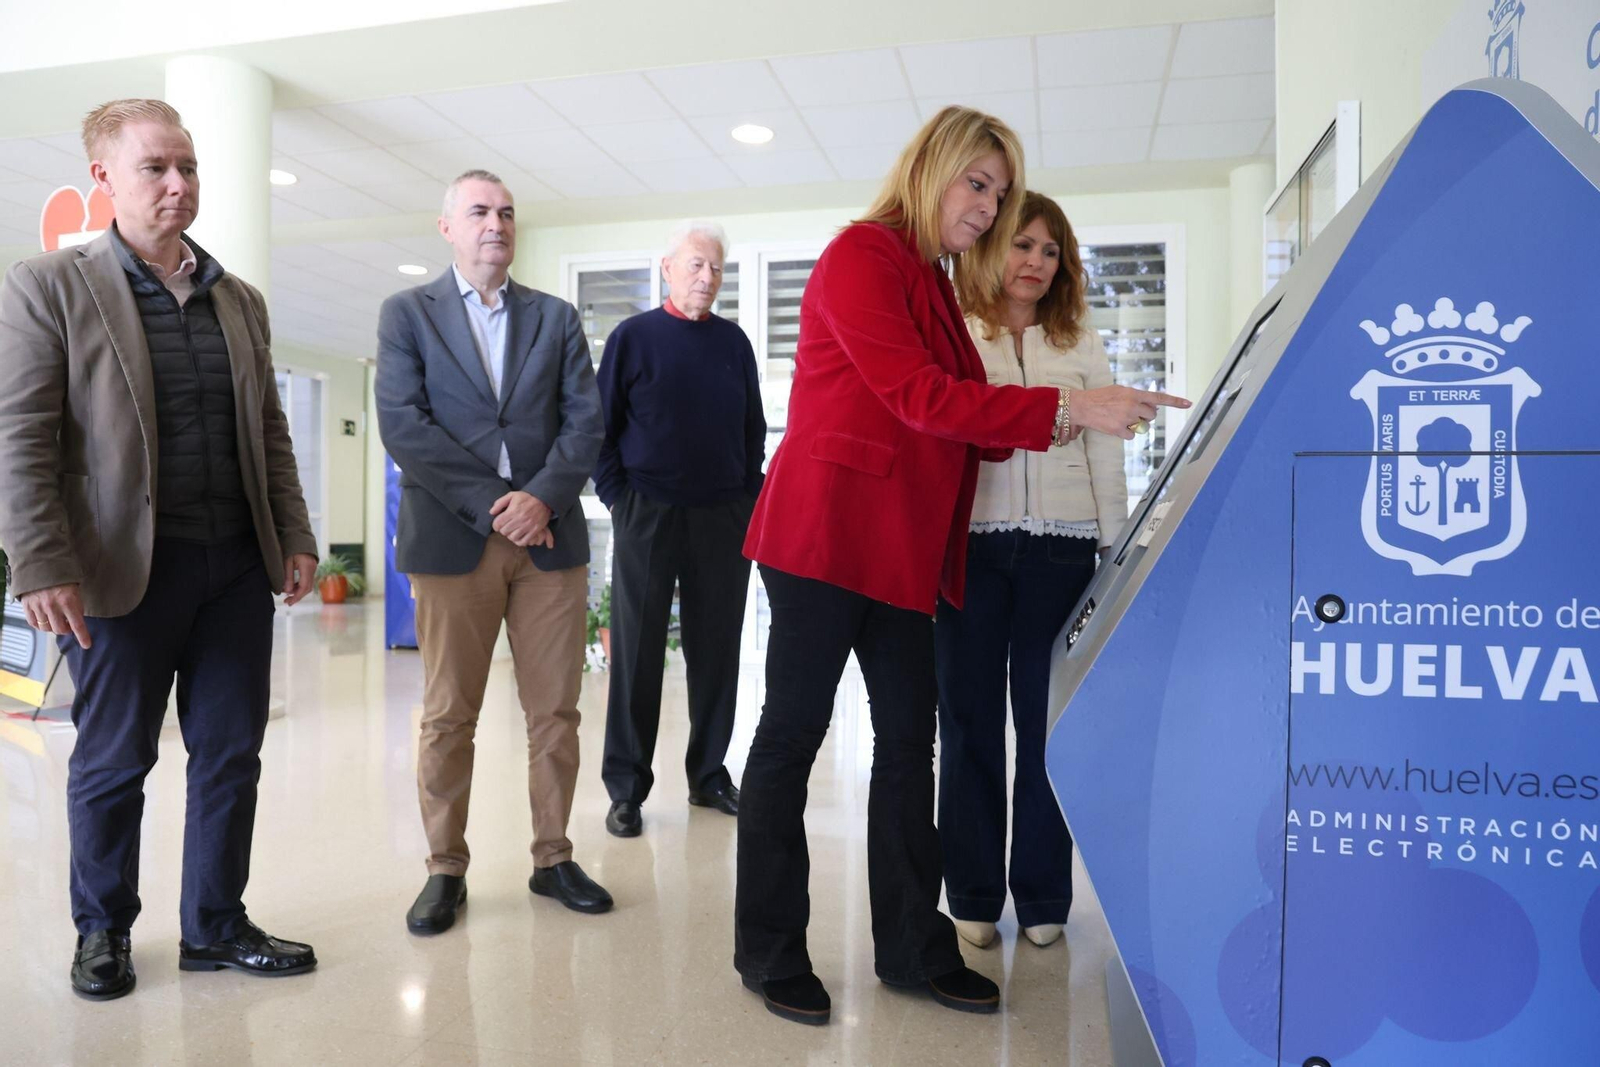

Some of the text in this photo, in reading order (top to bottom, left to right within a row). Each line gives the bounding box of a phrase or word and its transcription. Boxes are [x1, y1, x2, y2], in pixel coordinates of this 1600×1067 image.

[1409, 390, 1426, 401] ET
[1381, 463, 1393, 516] PORTUS
[1556, 598, 1600, 629] de
[1291, 641, 1600, 703] HUELVA
[1288, 759, 1599, 800] www.huelva.es
[1287, 809, 1598, 842] ADMINISTRACIÓN
[1286, 834, 1598, 869] ELECTRÓNICA
